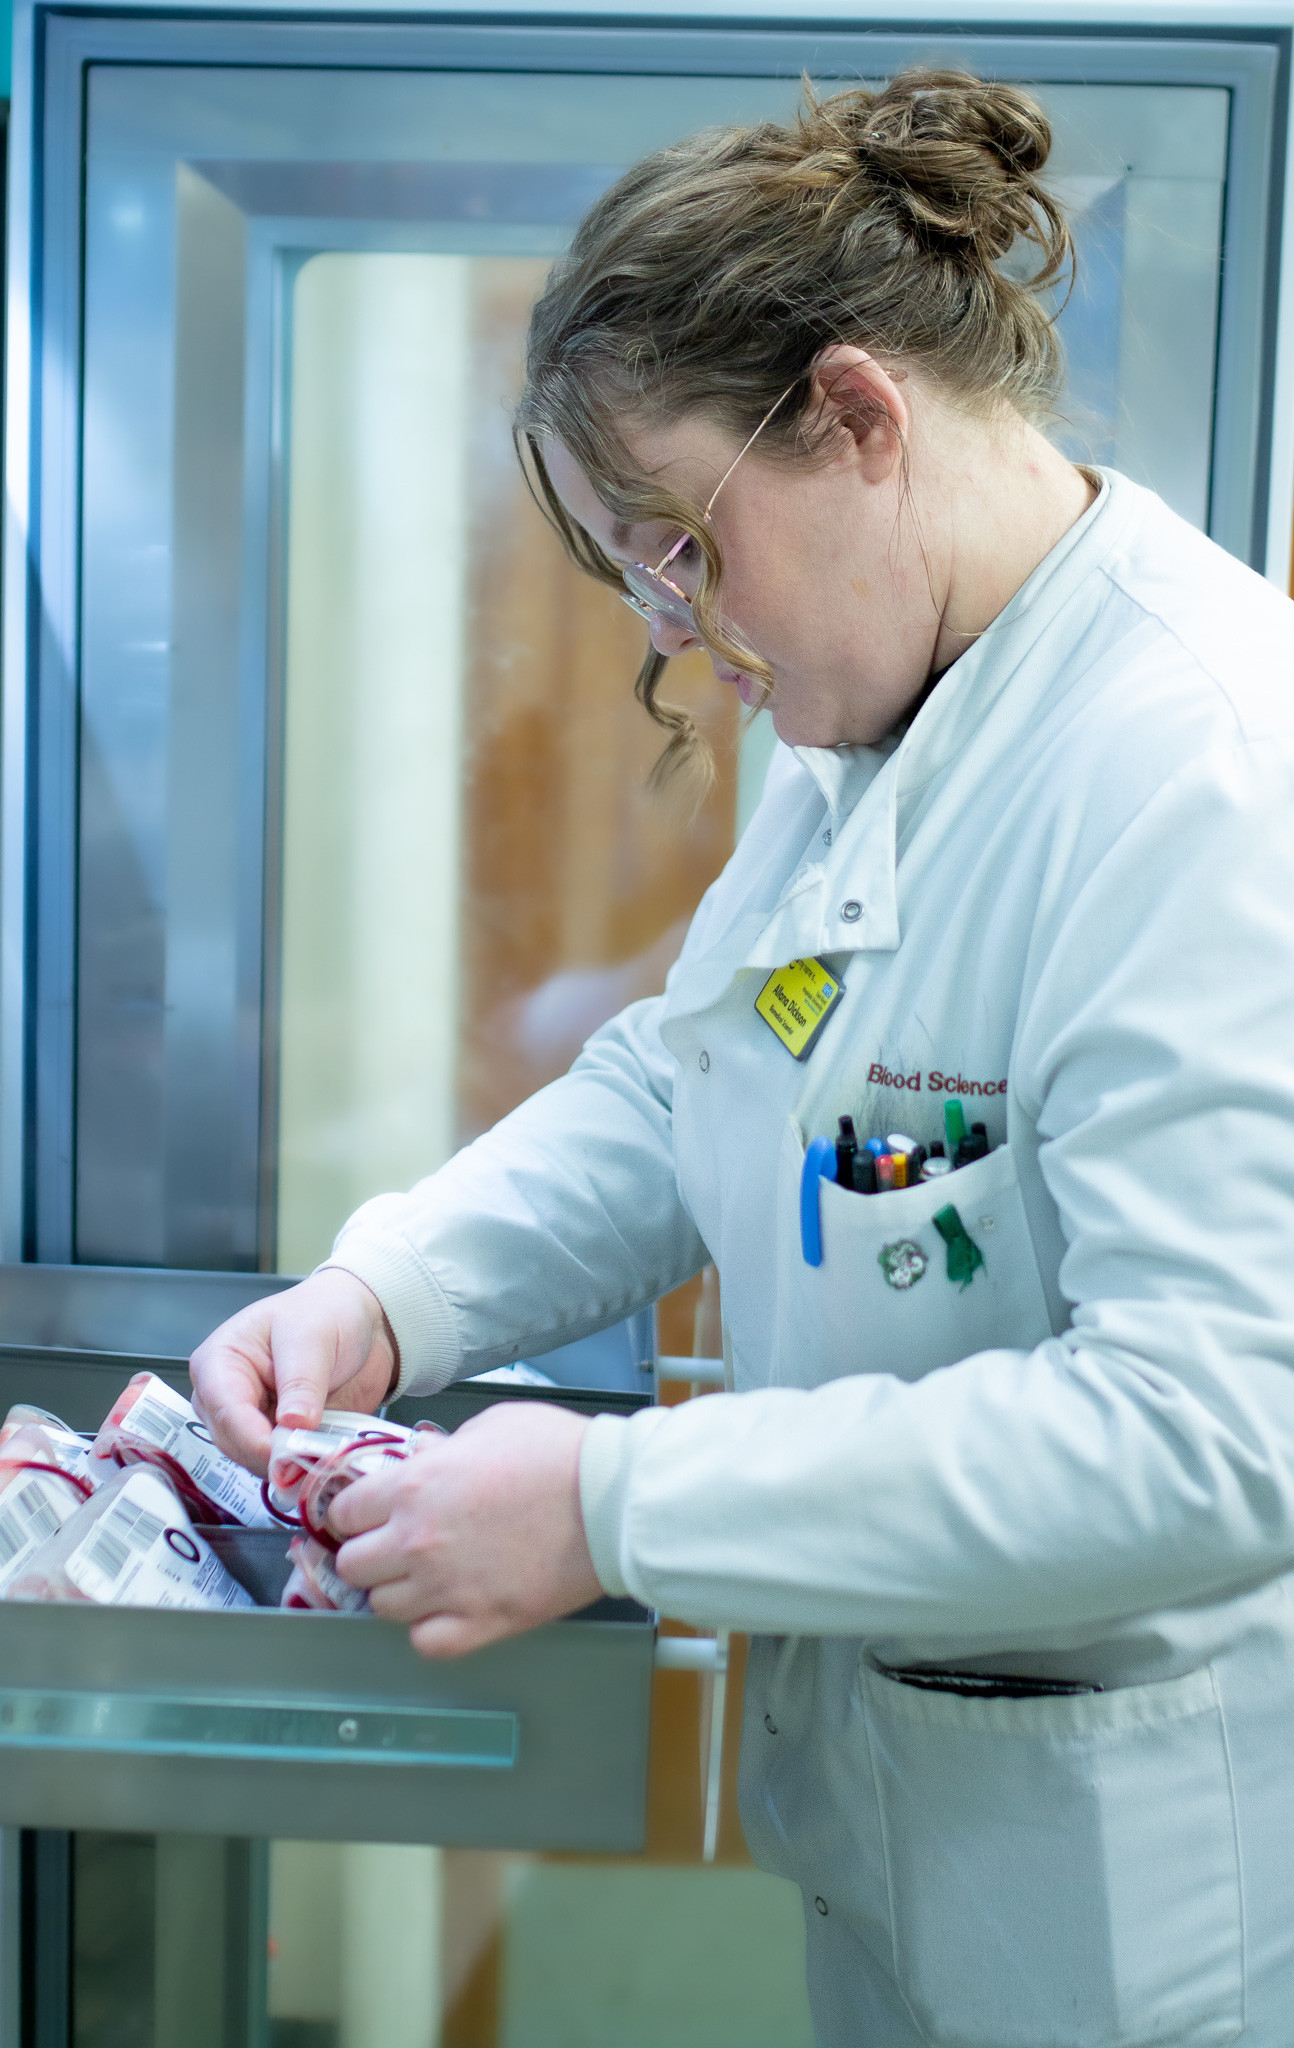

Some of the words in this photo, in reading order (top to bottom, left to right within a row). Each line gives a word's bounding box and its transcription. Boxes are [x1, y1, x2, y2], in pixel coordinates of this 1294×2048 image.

[787, 1000, 807, 1027] Dickson
[867, 1062, 921, 1092] Blood
[163, 1527, 201, 1563] O
